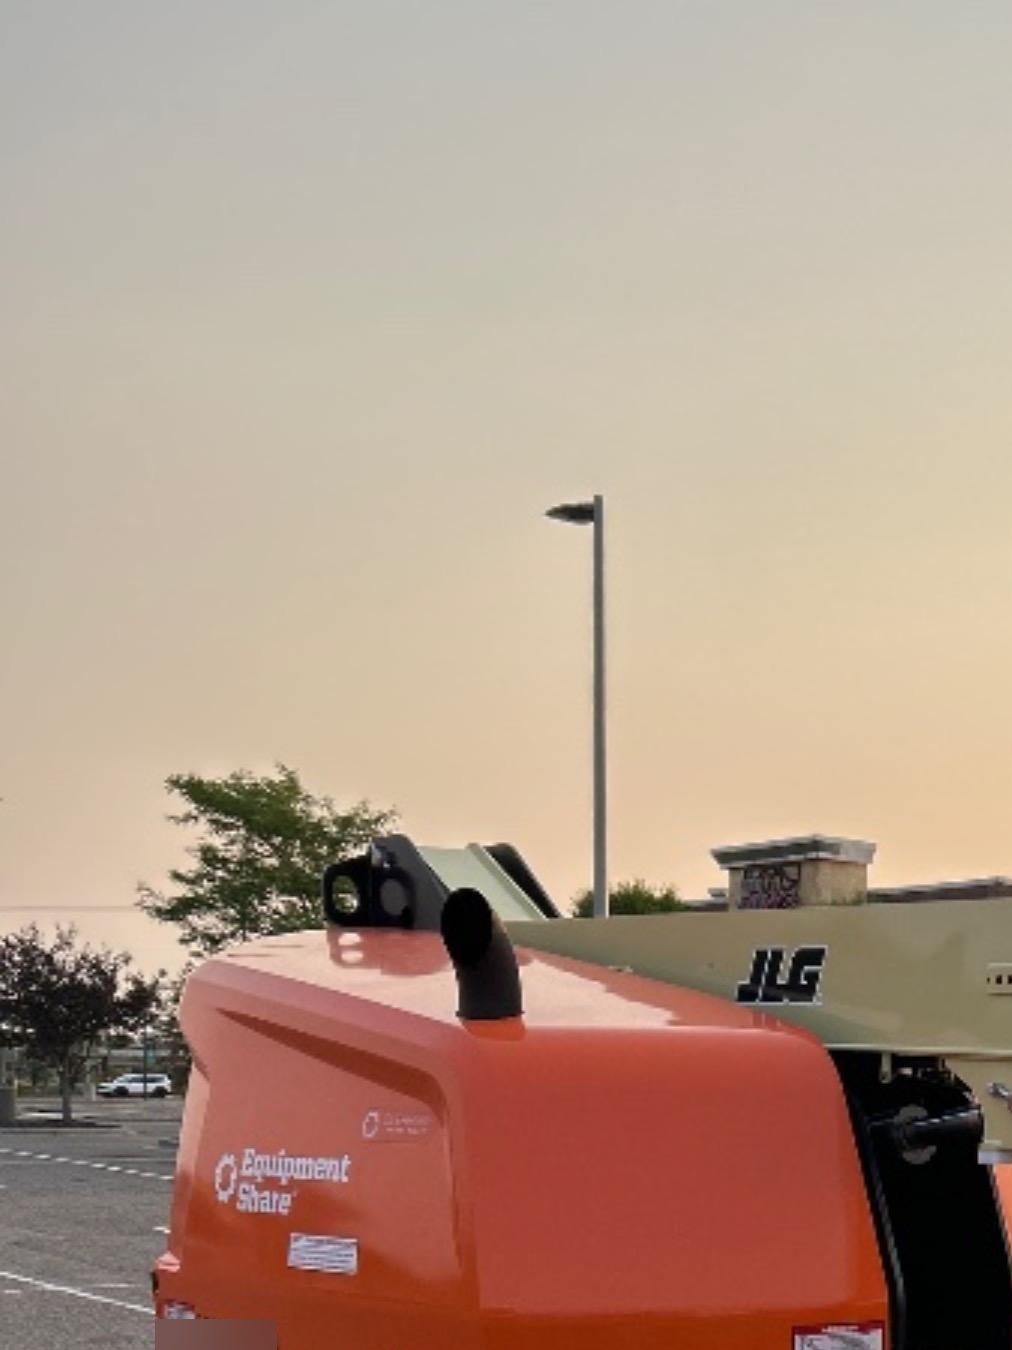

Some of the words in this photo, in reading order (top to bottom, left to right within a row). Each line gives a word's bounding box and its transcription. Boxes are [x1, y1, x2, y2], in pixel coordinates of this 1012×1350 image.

[736, 946, 827, 1005] JLG
[241, 1148, 351, 1185] Equipment
[237, 1184, 292, 1215] Share
